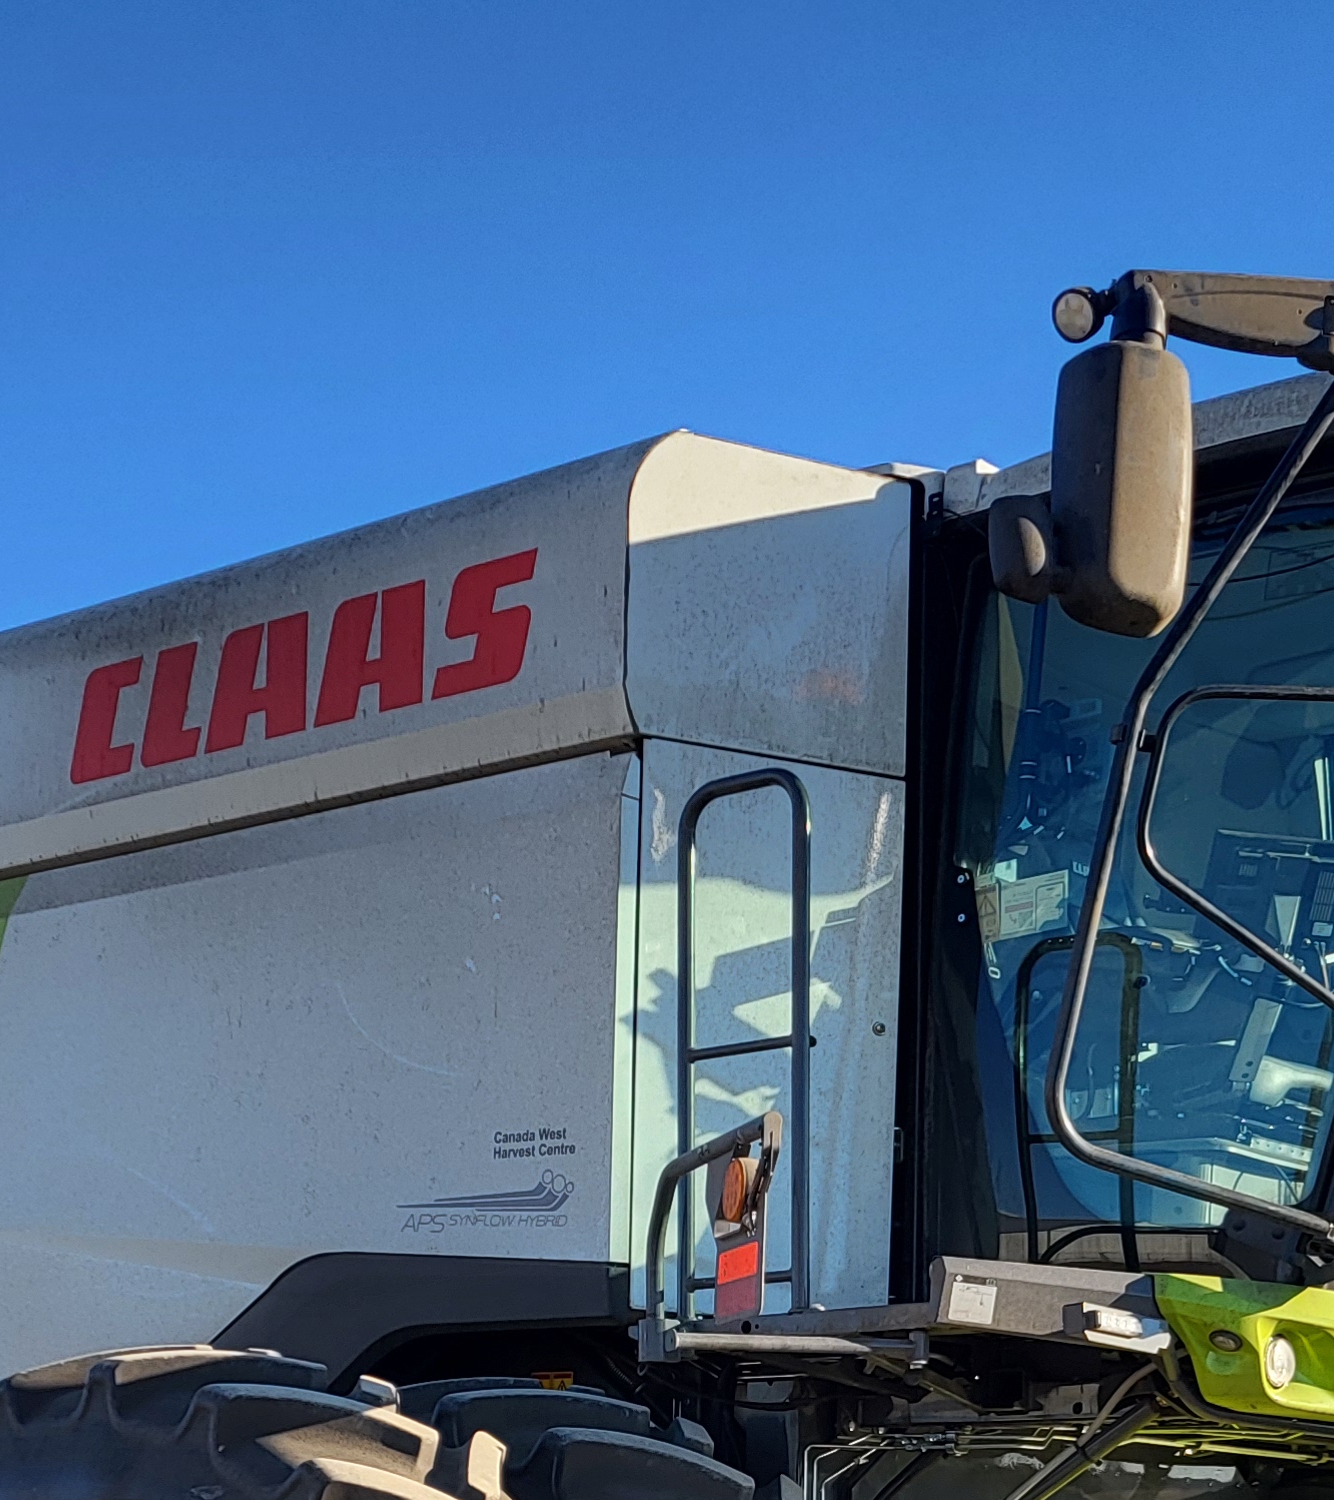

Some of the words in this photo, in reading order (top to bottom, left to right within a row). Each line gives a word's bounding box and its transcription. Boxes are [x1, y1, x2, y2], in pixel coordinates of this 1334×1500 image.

[70, 547, 538, 785] CLAAS
[494, 1129, 535, 1144] Canada
[538, 1127, 567, 1141] West
[493, 1145, 536, 1160] Harvest
[538, 1143, 576, 1157] Centre
[400, 1213, 448, 1233] APS
[448, 1213, 516, 1227] SYNFLOW
[517, 1214, 569, 1227] HYBRID
